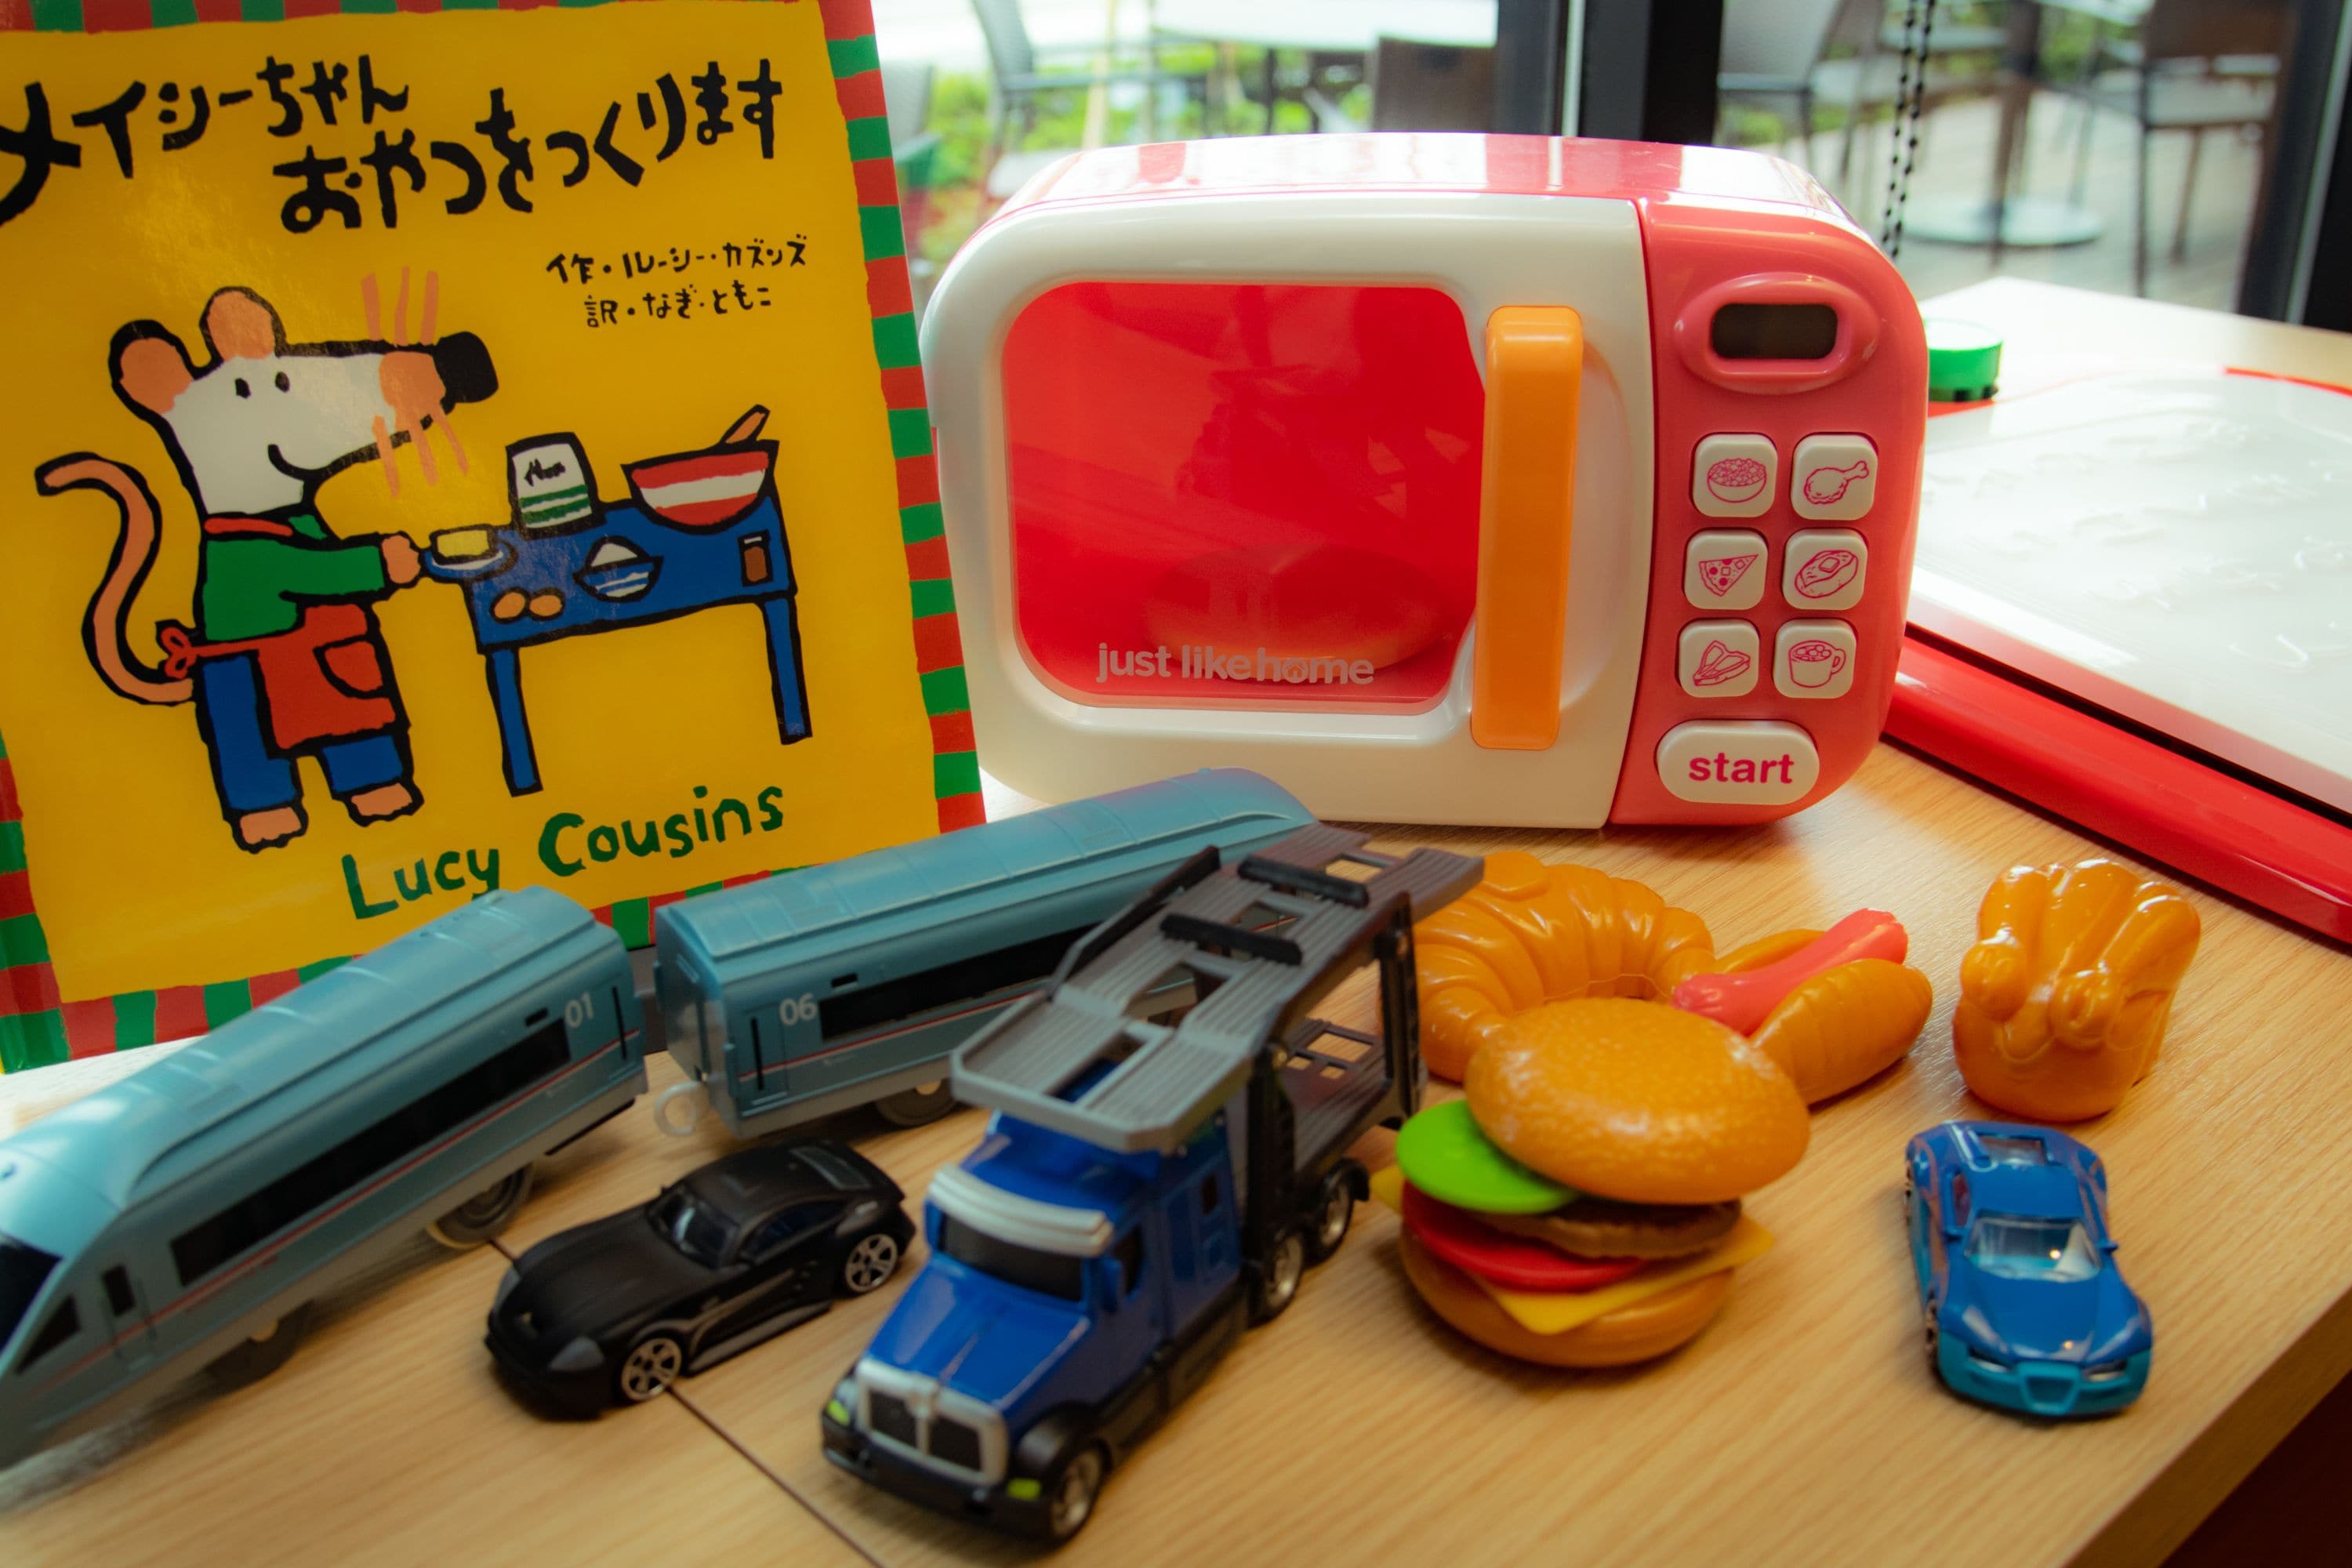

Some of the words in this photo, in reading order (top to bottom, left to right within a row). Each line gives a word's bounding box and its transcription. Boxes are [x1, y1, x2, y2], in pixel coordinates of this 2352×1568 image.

[0, 55, 409, 227] メイシーちゃん
[274, 59, 783, 234] おやつをつくります
[1096, 642, 1172, 684] just
[1181, 644, 1251, 681] like
[1256, 647, 1374, 685] home
[1688, 752, 1795, 784] start
[341, 849, 500, 920] Lucy
[538, 785, 783, 877] Cousins
[564, 992, 594, 1029] 01
[779, 993, 817, 1026] 06
